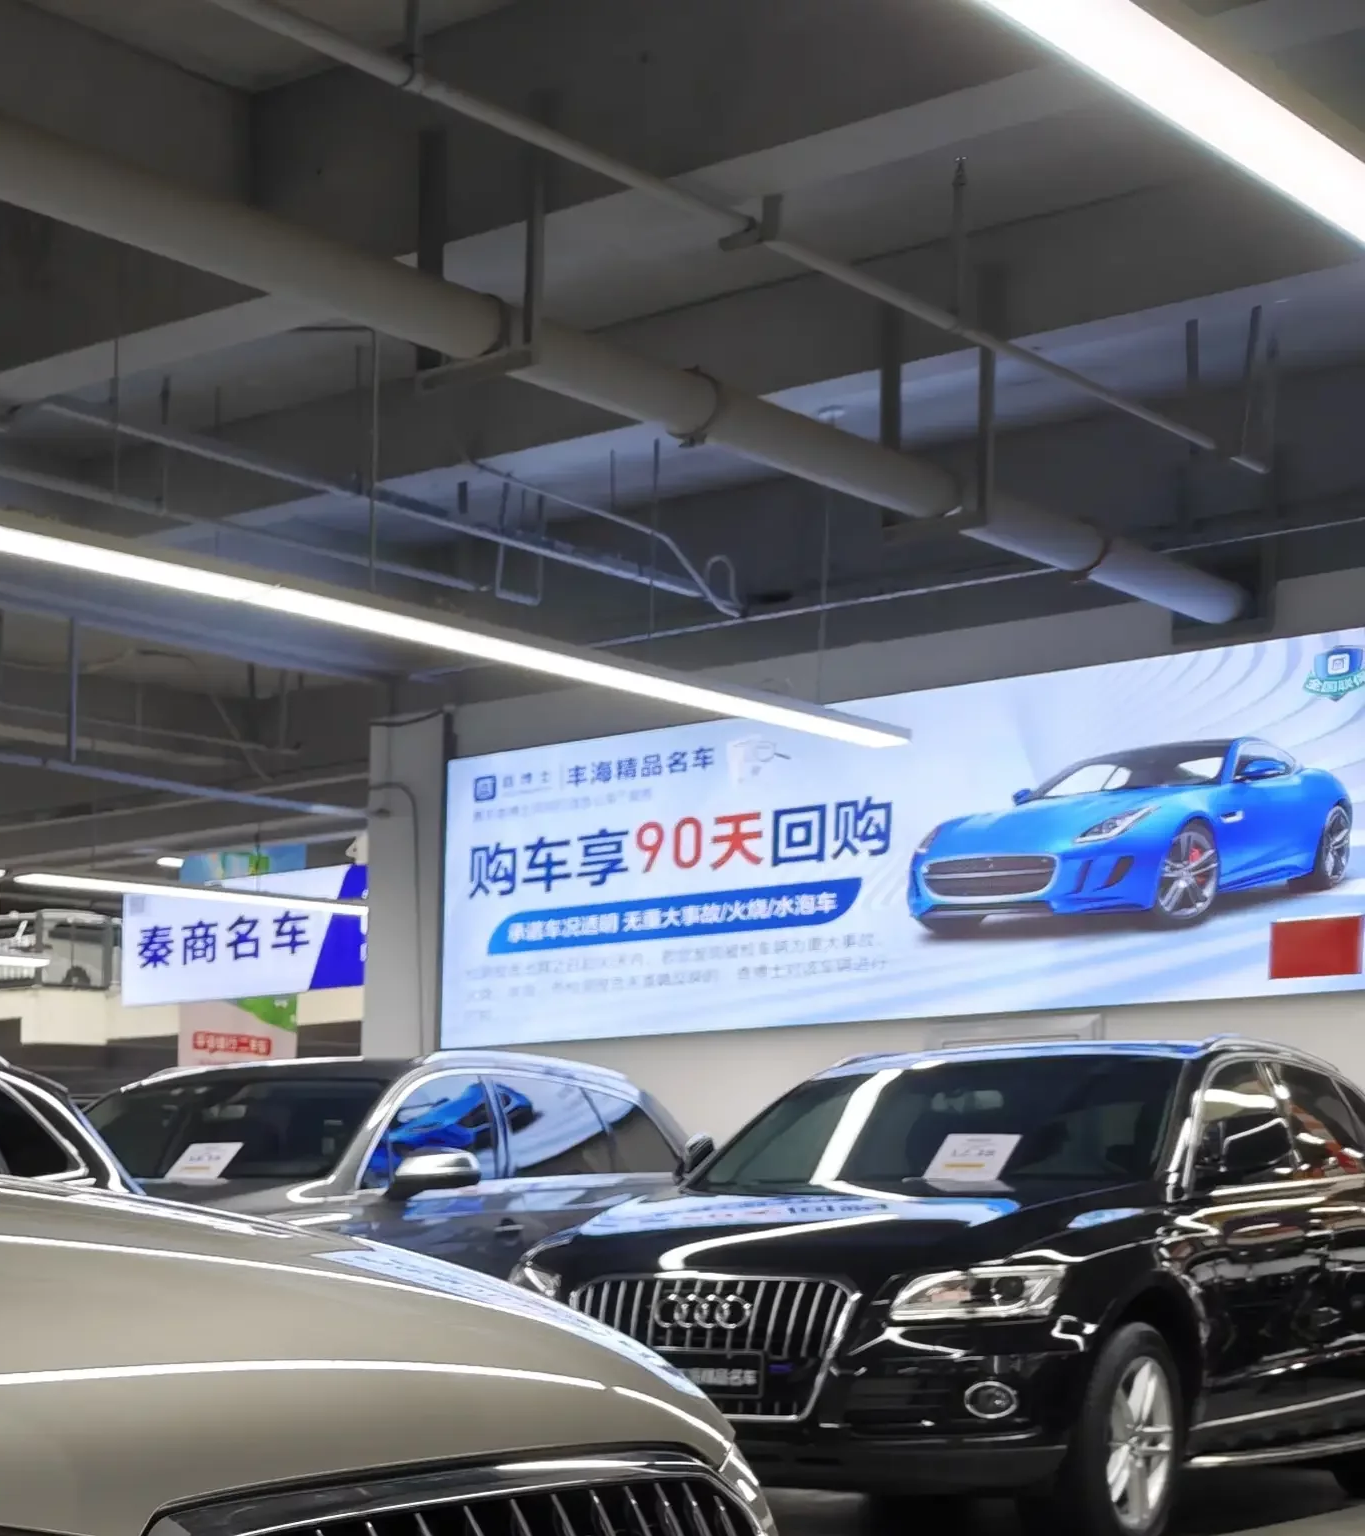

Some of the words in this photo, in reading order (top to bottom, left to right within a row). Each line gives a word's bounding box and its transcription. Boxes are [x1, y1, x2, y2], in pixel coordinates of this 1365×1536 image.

[567, 746, 715, 787] 丰海精品名车
[469, 796, 892, 899] 购车享90天回购
[137, 911, 310, 969] 秦商名车
